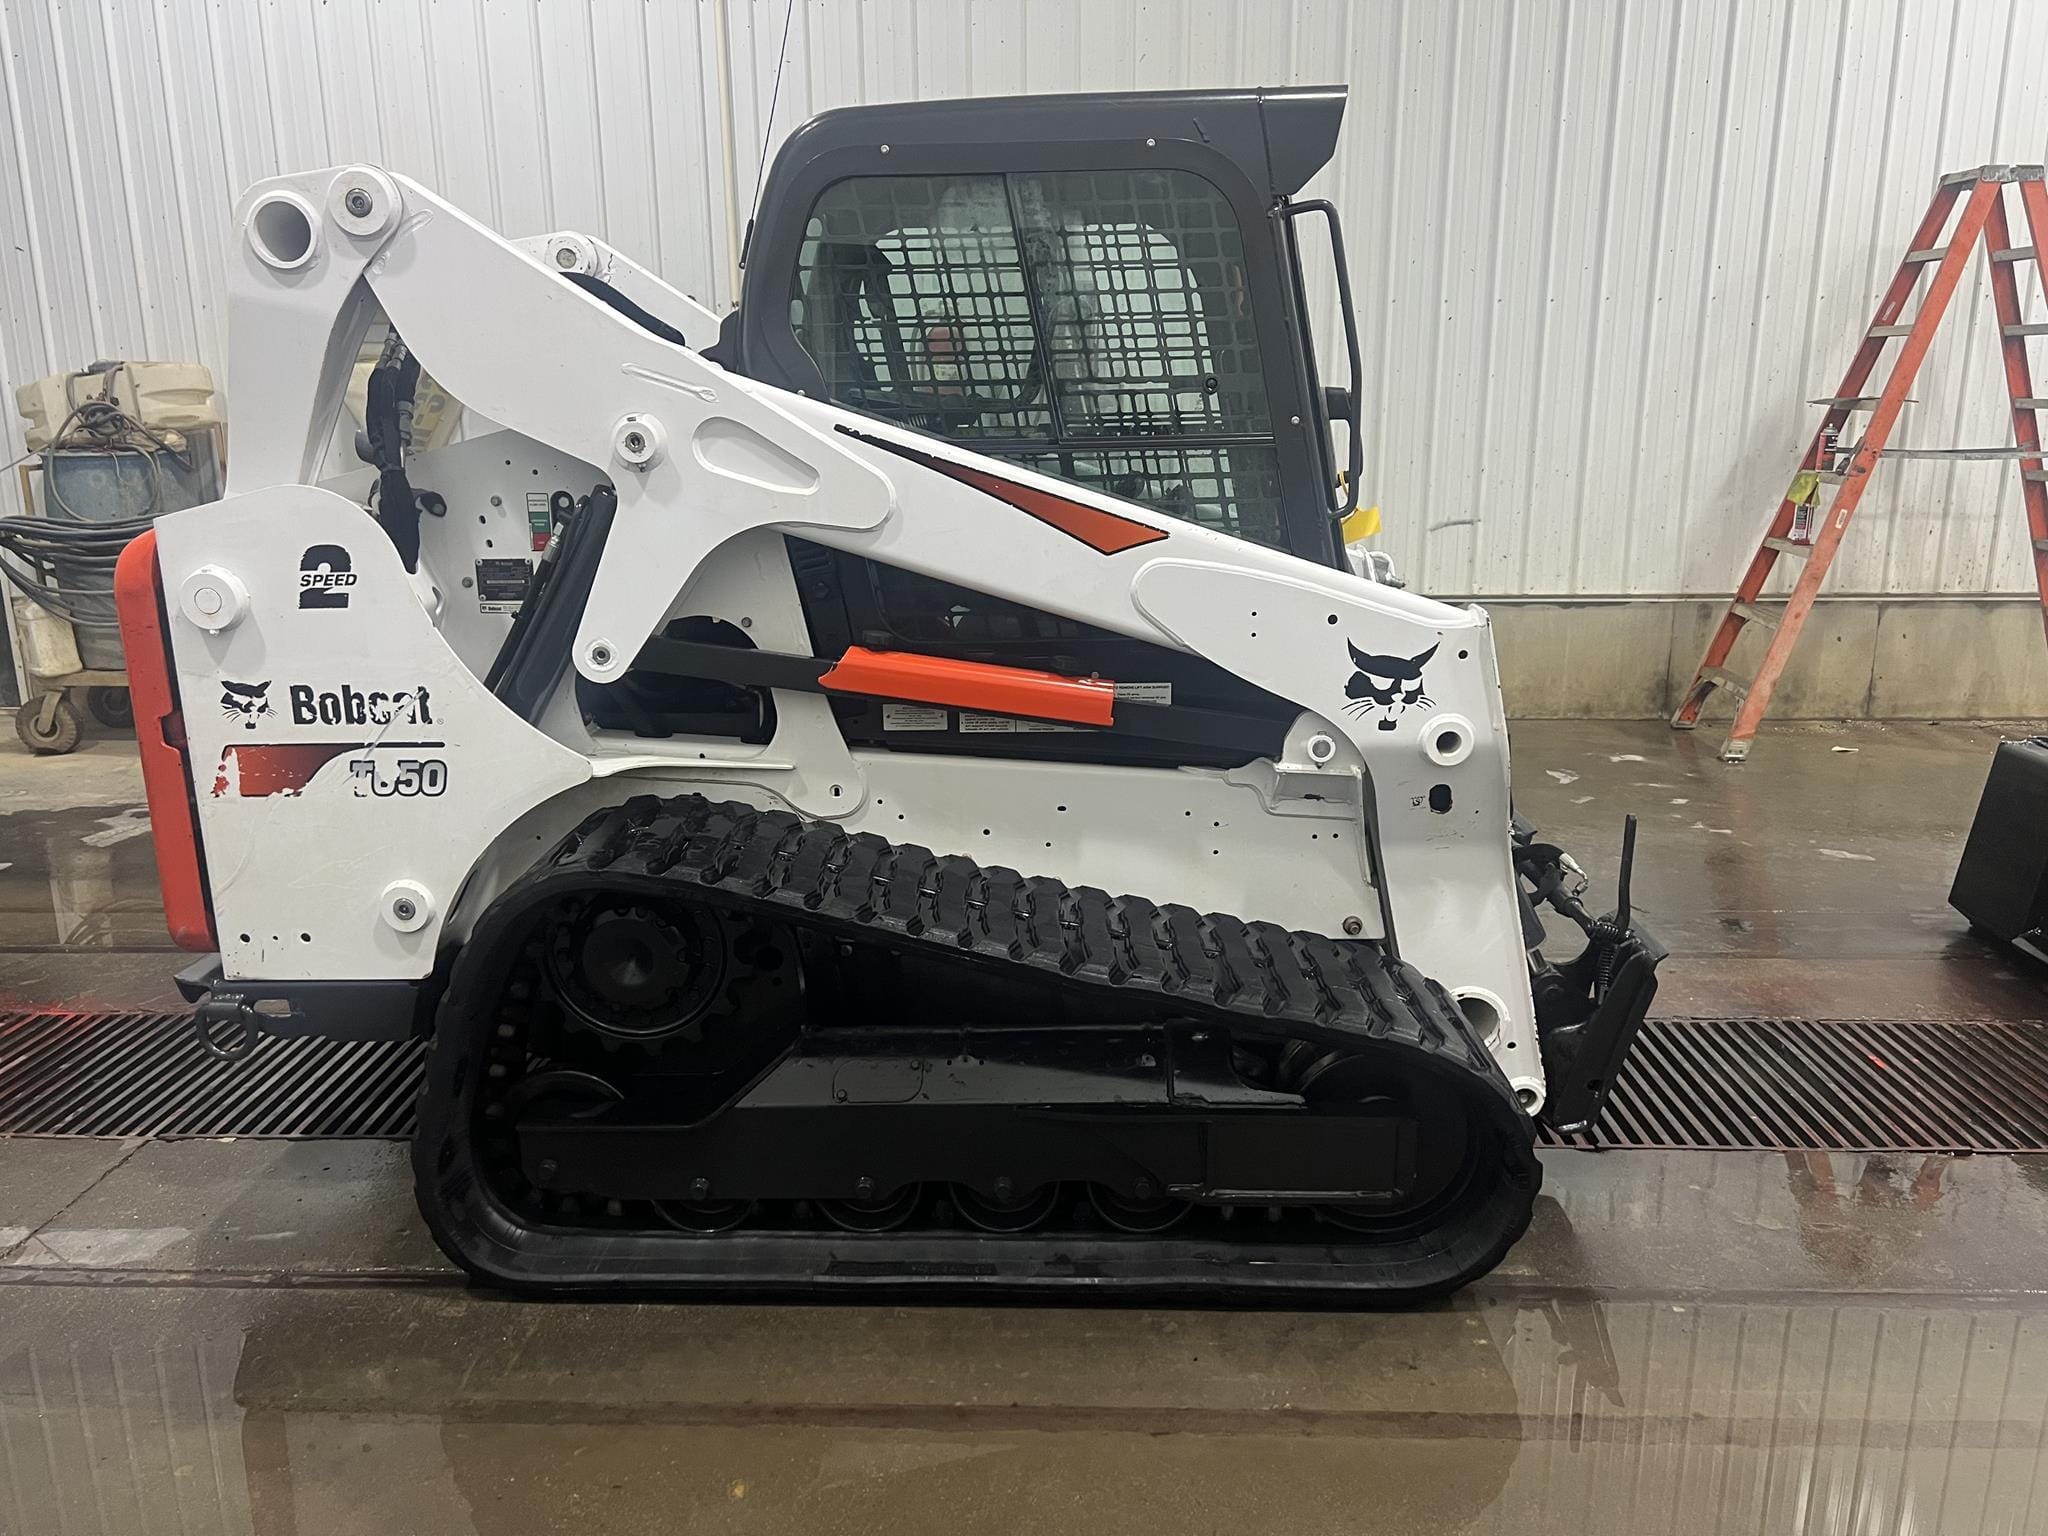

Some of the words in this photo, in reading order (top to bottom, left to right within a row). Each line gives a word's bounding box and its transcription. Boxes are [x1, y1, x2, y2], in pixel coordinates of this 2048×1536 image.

[299, 544, 351, 609] 2
[299, 573, 358, 587] SPEED
[289, 684, 433, 725] Bobcat
